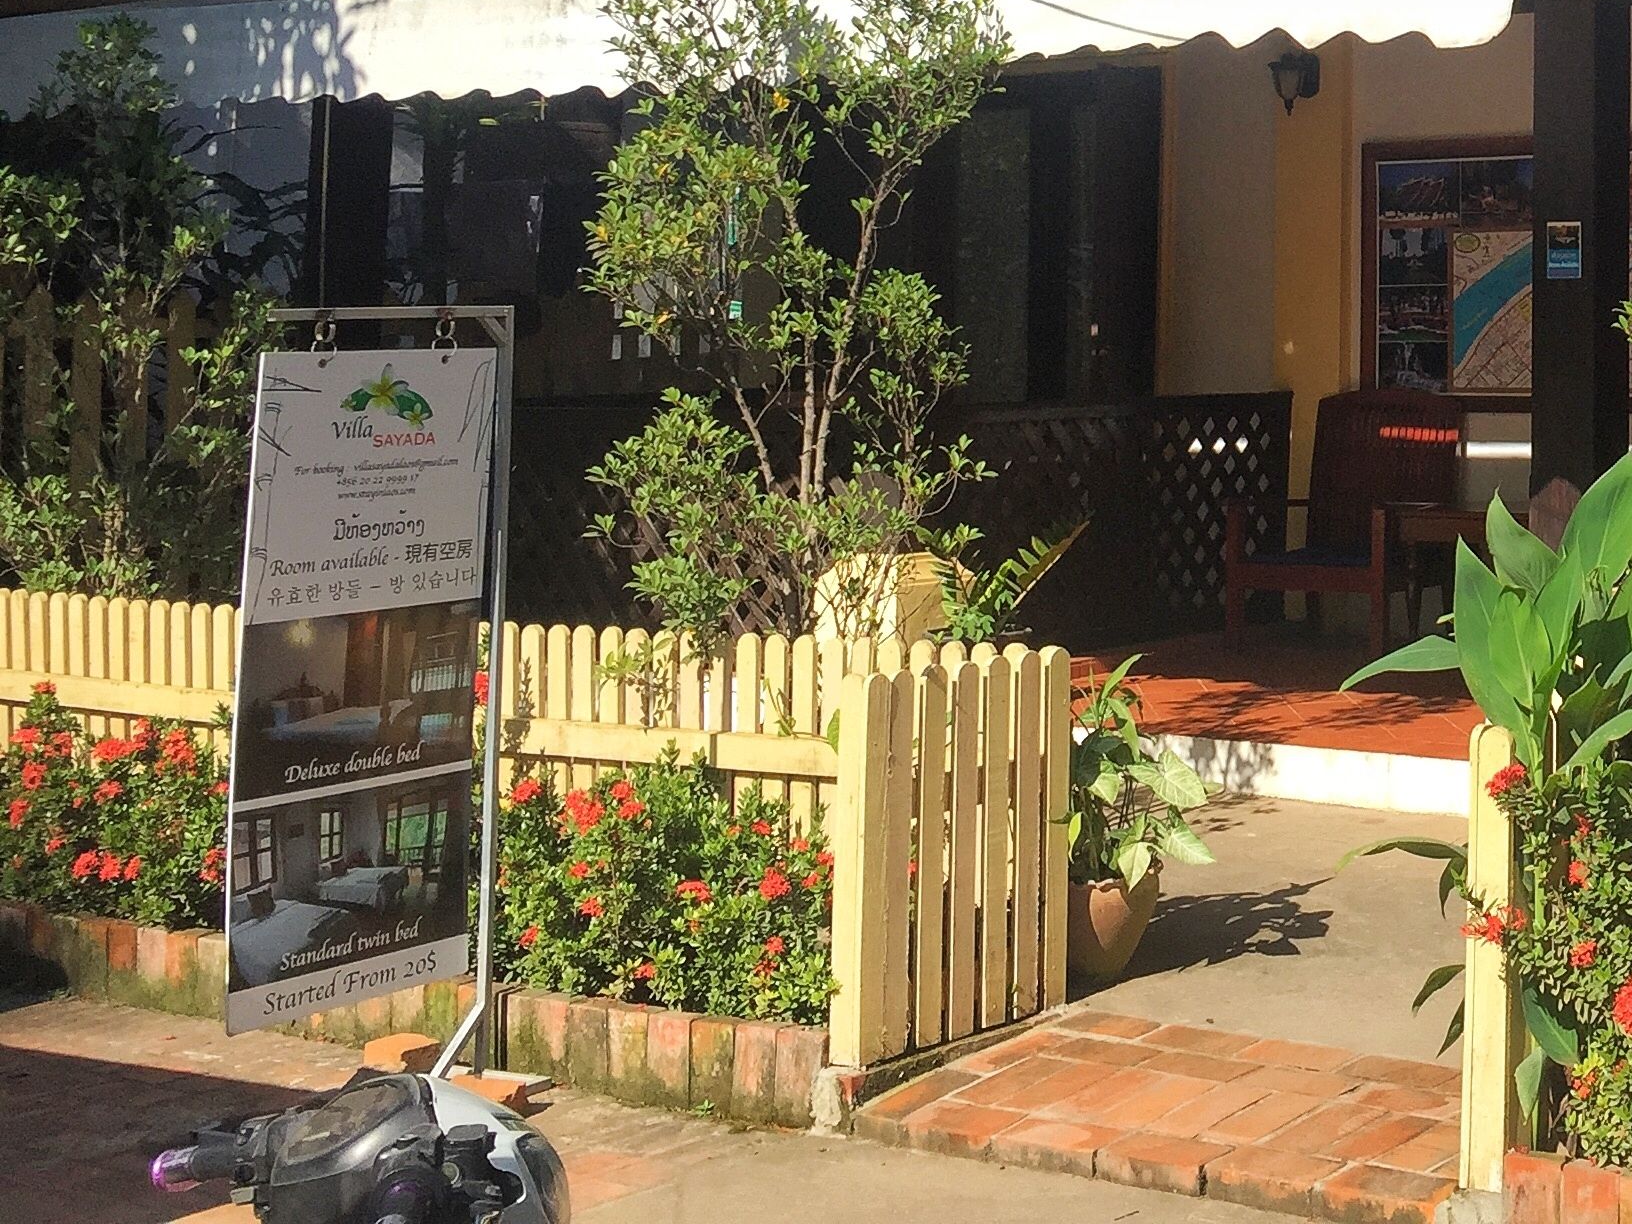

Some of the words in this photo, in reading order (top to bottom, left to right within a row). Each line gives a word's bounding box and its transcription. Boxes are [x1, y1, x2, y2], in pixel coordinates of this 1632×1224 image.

[332, 416, 374, 440] Villa
[372, 431, 436, 448] SAYADA
[270, 558, 315, 577] Room
[321, 547, 389, 572] available
[404, 539, 473, 564] 現有空房
[267, 584, 321, 607] 유효한
[328, 578, 361, 601] 방들
[389, 575, 405, 594] 방
[412, 566, 477, 591] 있습니다
[284, 759, 341, 785] Deluxe
[344, 746, 393, 776] double
[395, 741, 422, 762] bed
[280, 942, 355, 972] Standard
[357, 927, 390, 952] twin
[394, 917, 420, 940] bed
[263, 971, 339, 1017] Started
[343, 968, 396, 996] From
[403, 949, 437, 978] 20$
